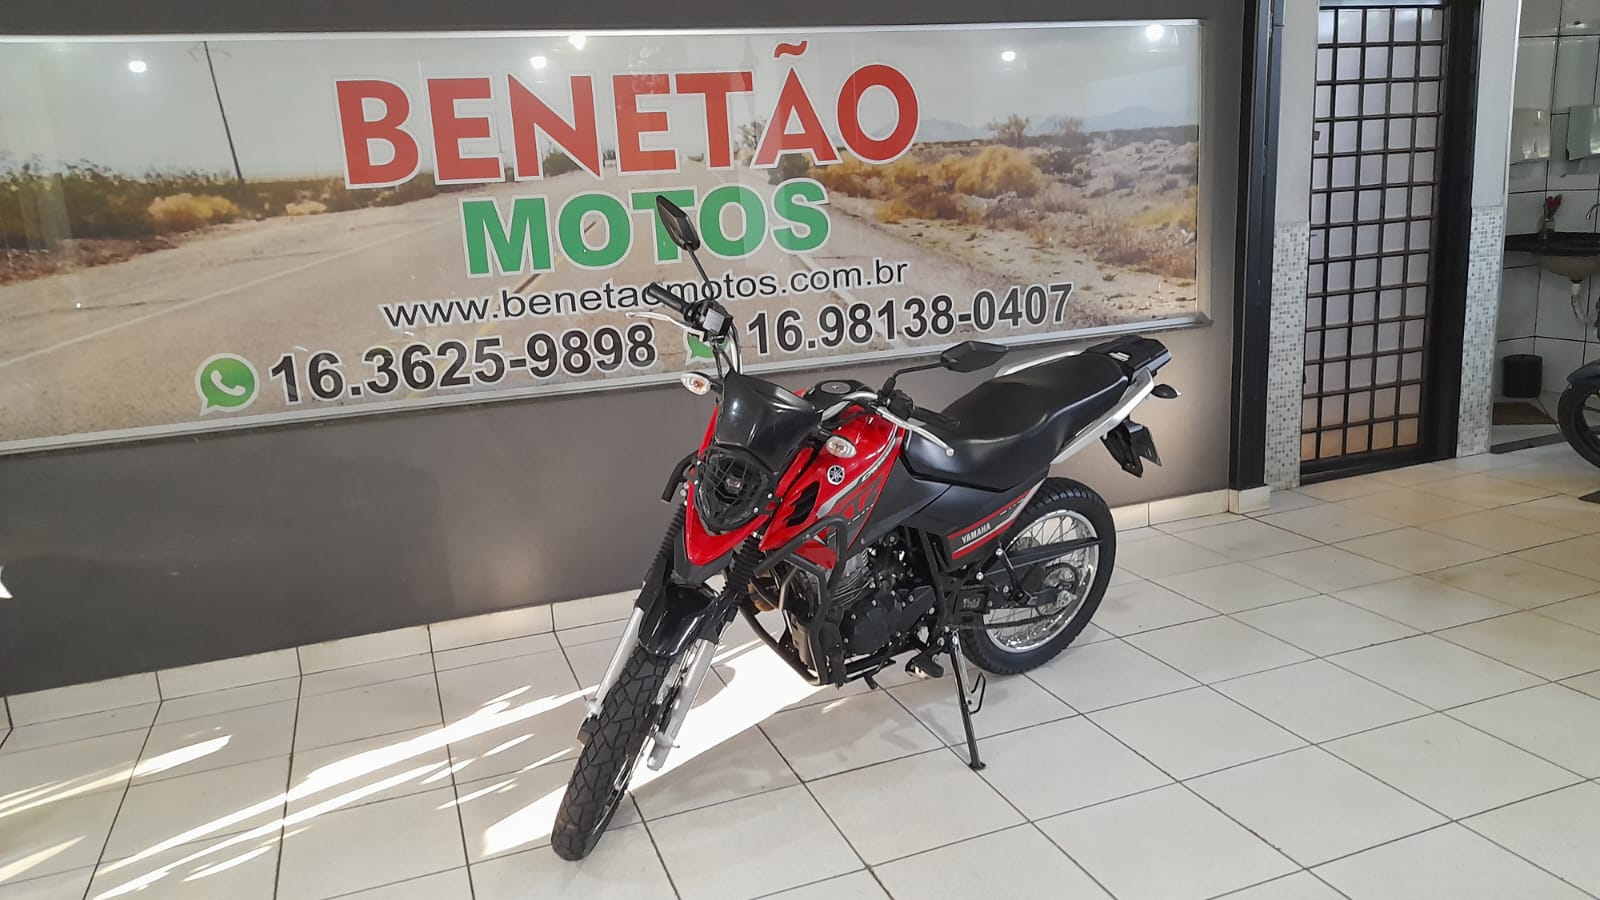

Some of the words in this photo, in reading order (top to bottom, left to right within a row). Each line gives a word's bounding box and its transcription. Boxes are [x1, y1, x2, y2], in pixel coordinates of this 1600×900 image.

[335, 39, 919, 186] BENETÃO
[461, 180, 829, 275] MOTOS
[748, 283, 1073, 355] 16.98138-0407
[271, 325, 655, 402] 16.3625-9898
[961, 522, 992, 544] YAMAHA
